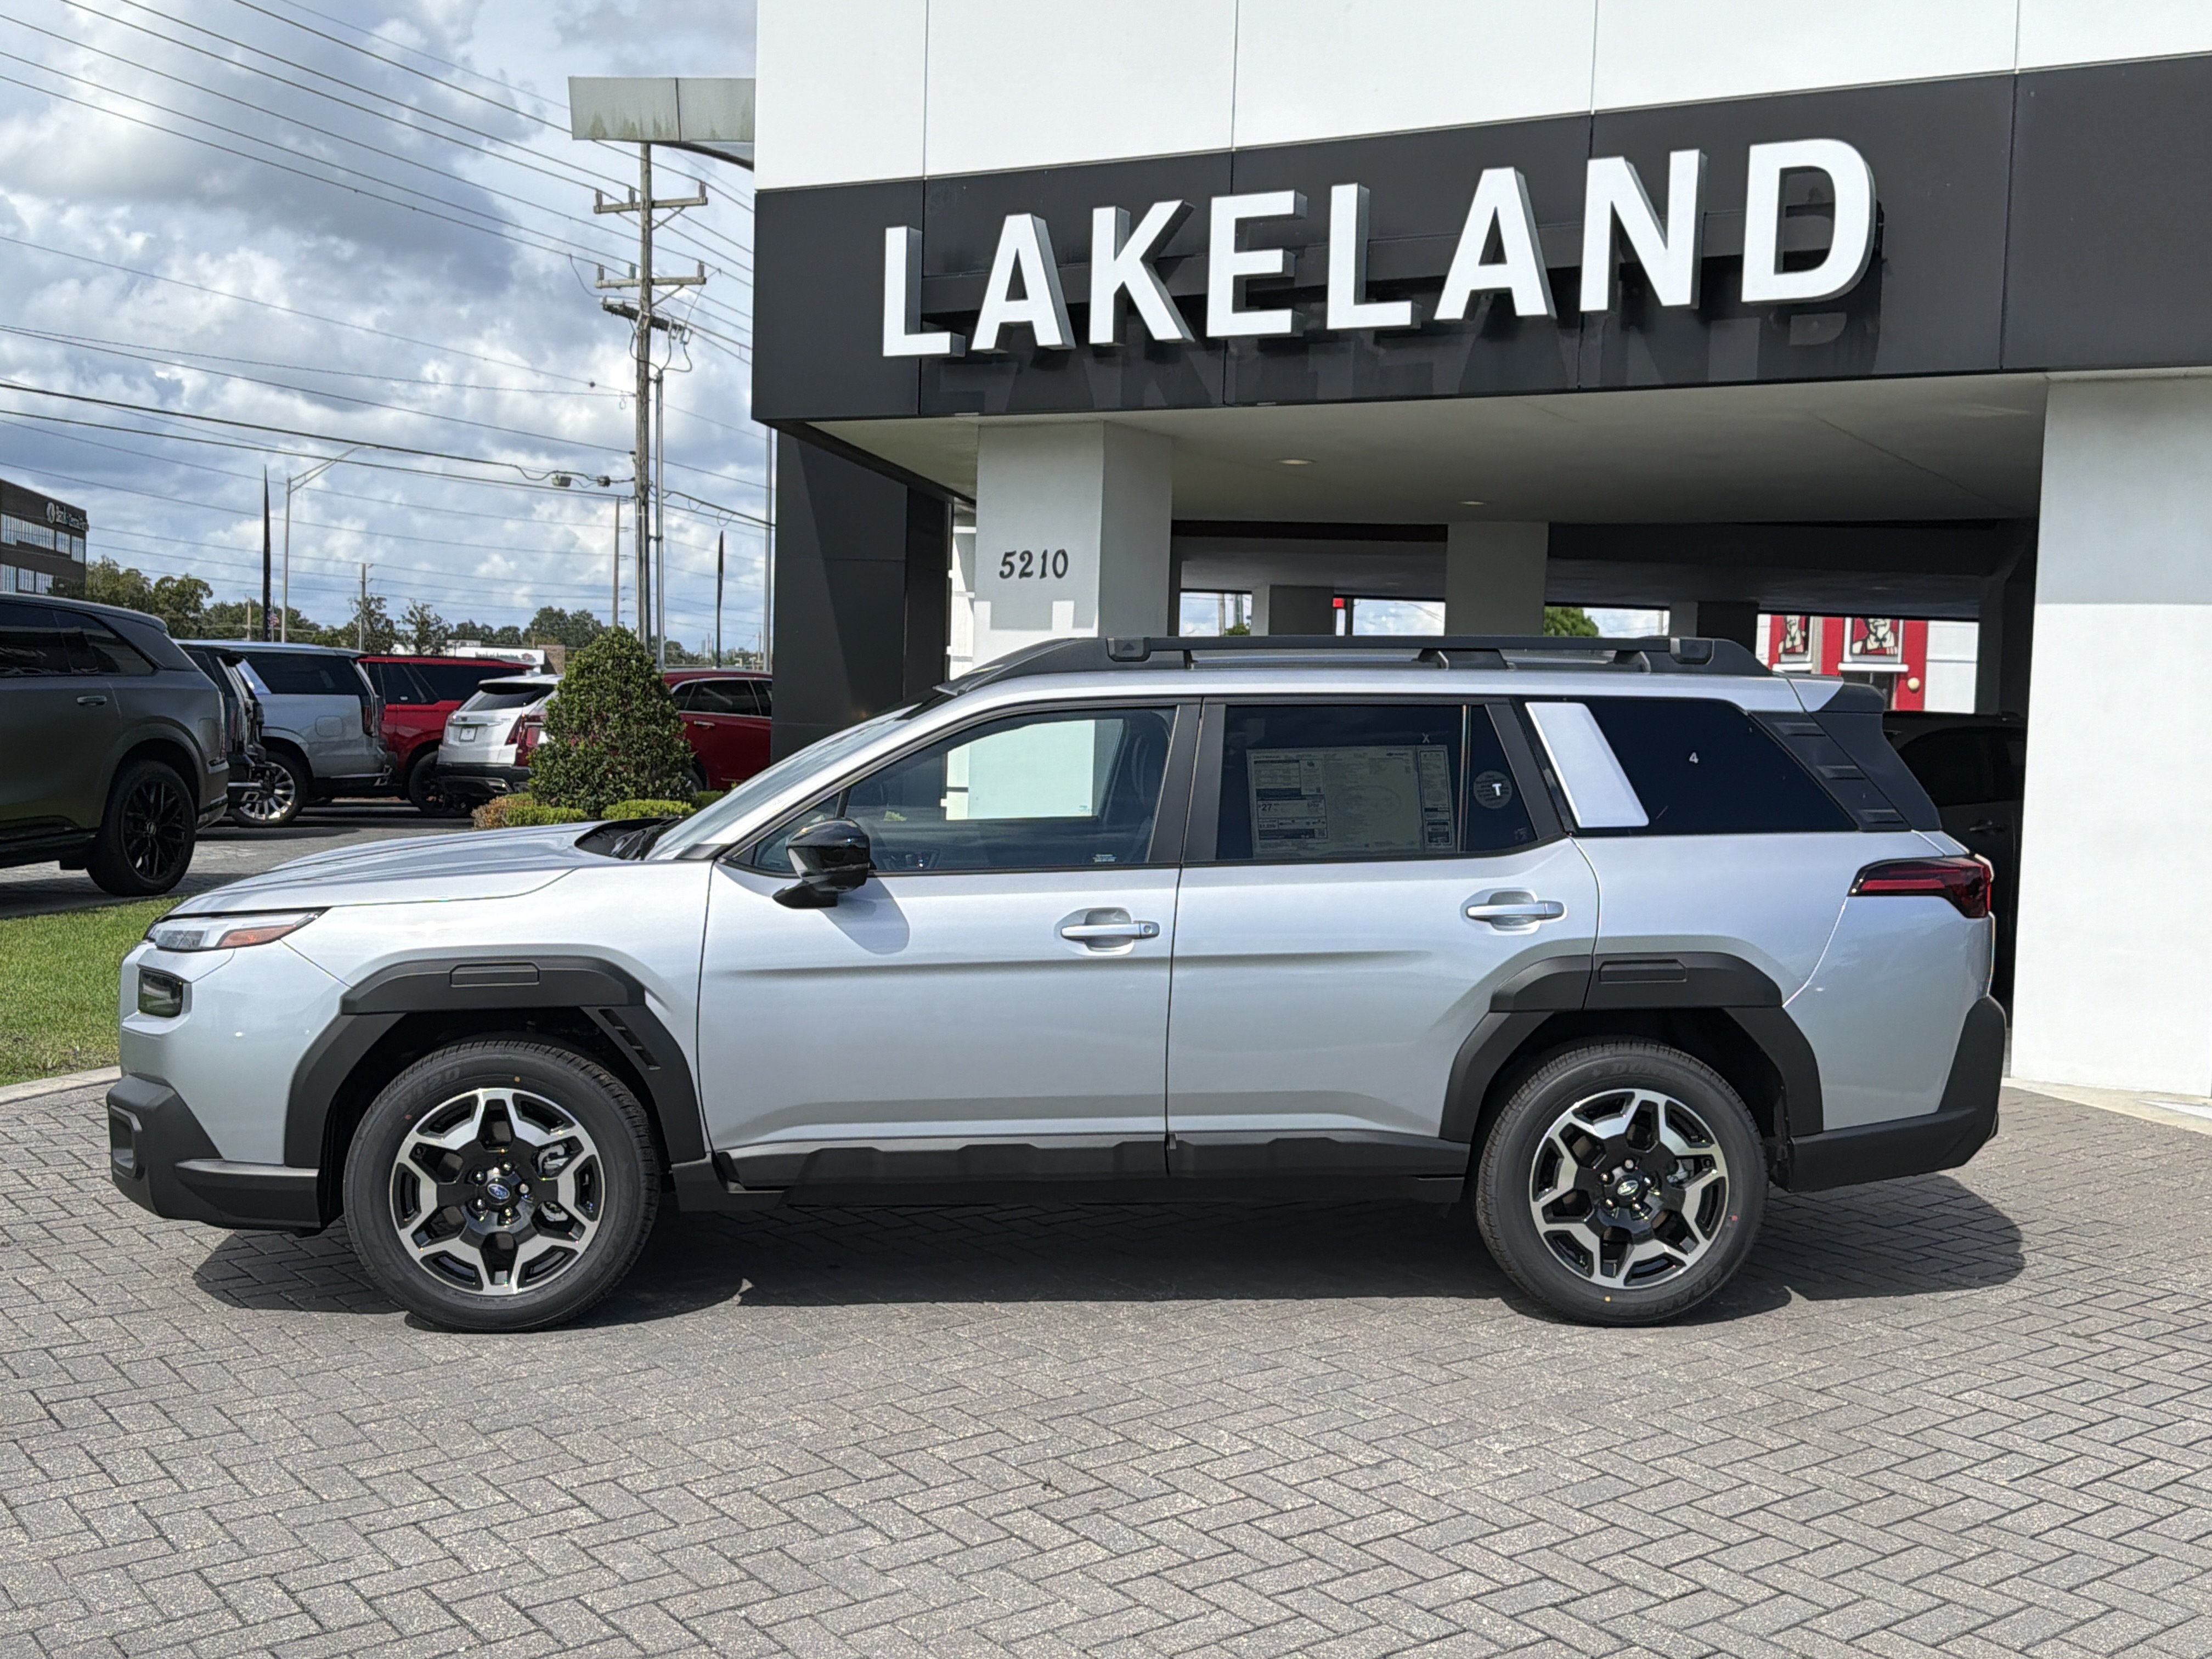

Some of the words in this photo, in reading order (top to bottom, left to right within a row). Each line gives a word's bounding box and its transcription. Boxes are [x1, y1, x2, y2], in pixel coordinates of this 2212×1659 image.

[882, 137, 1876, 358] LAKELAND
[999, 549, 1069, 579] 5210
[1689, 752, 1699, 763] 4
[1492, 783, 1502, 797] T
[1262, 803, 1272, 811] 27
